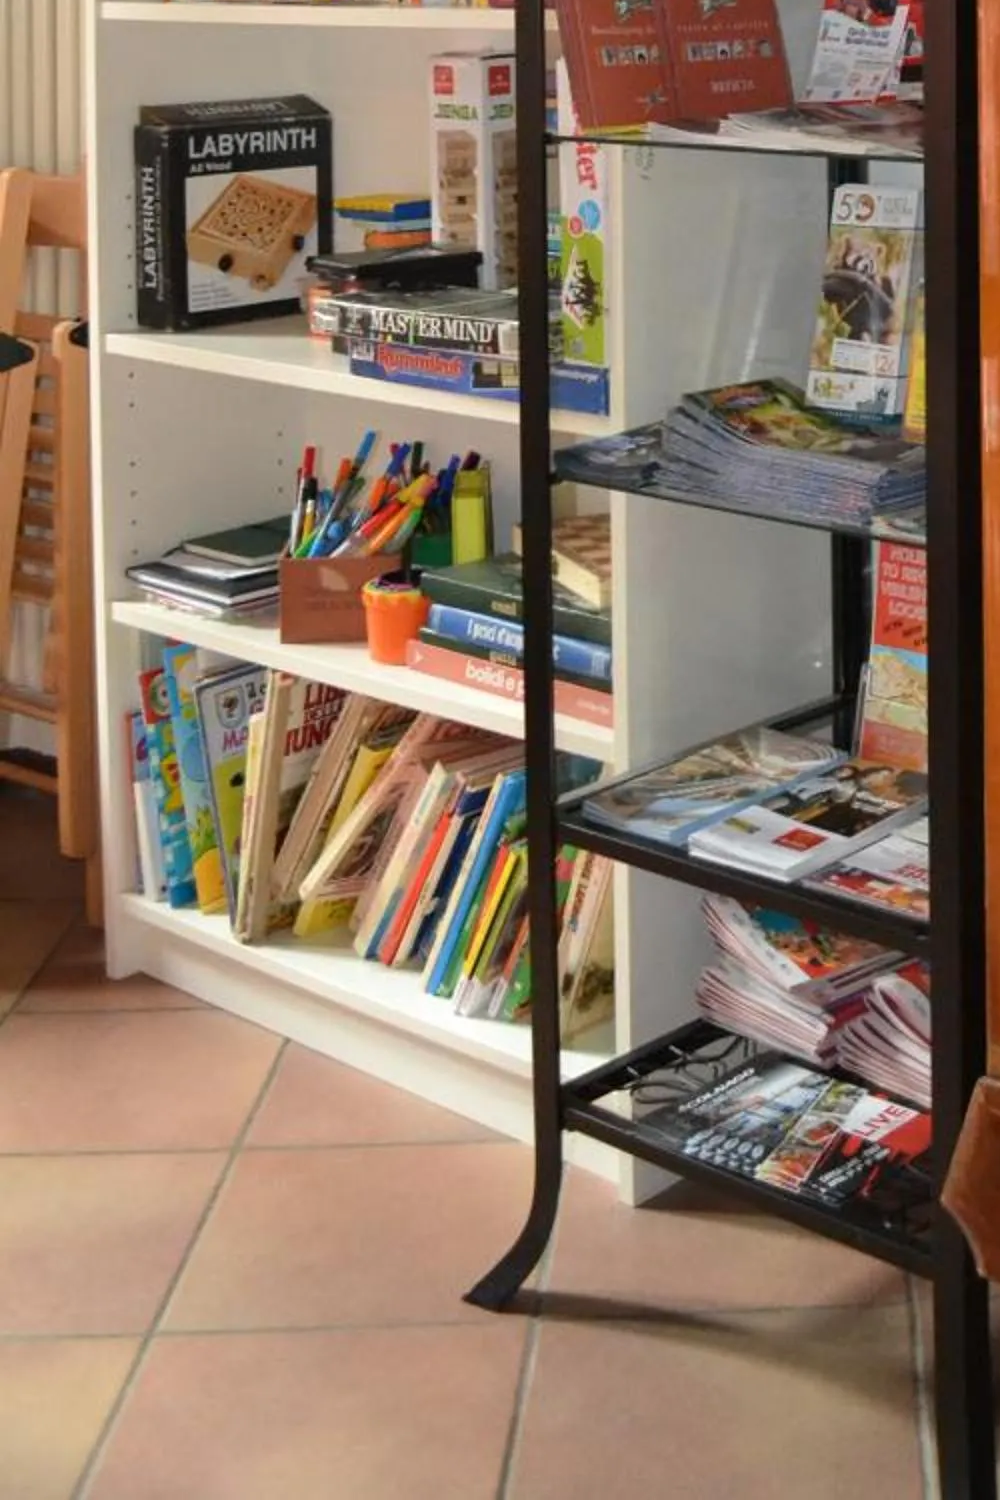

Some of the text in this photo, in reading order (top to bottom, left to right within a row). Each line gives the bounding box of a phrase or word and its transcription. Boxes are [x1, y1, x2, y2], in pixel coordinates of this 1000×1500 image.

[188, 127, 317, 160] LABYRINTH
[141, 166, 158, 290] LABYRINTH
[371, 308, 496, 343] MASTERMIND
